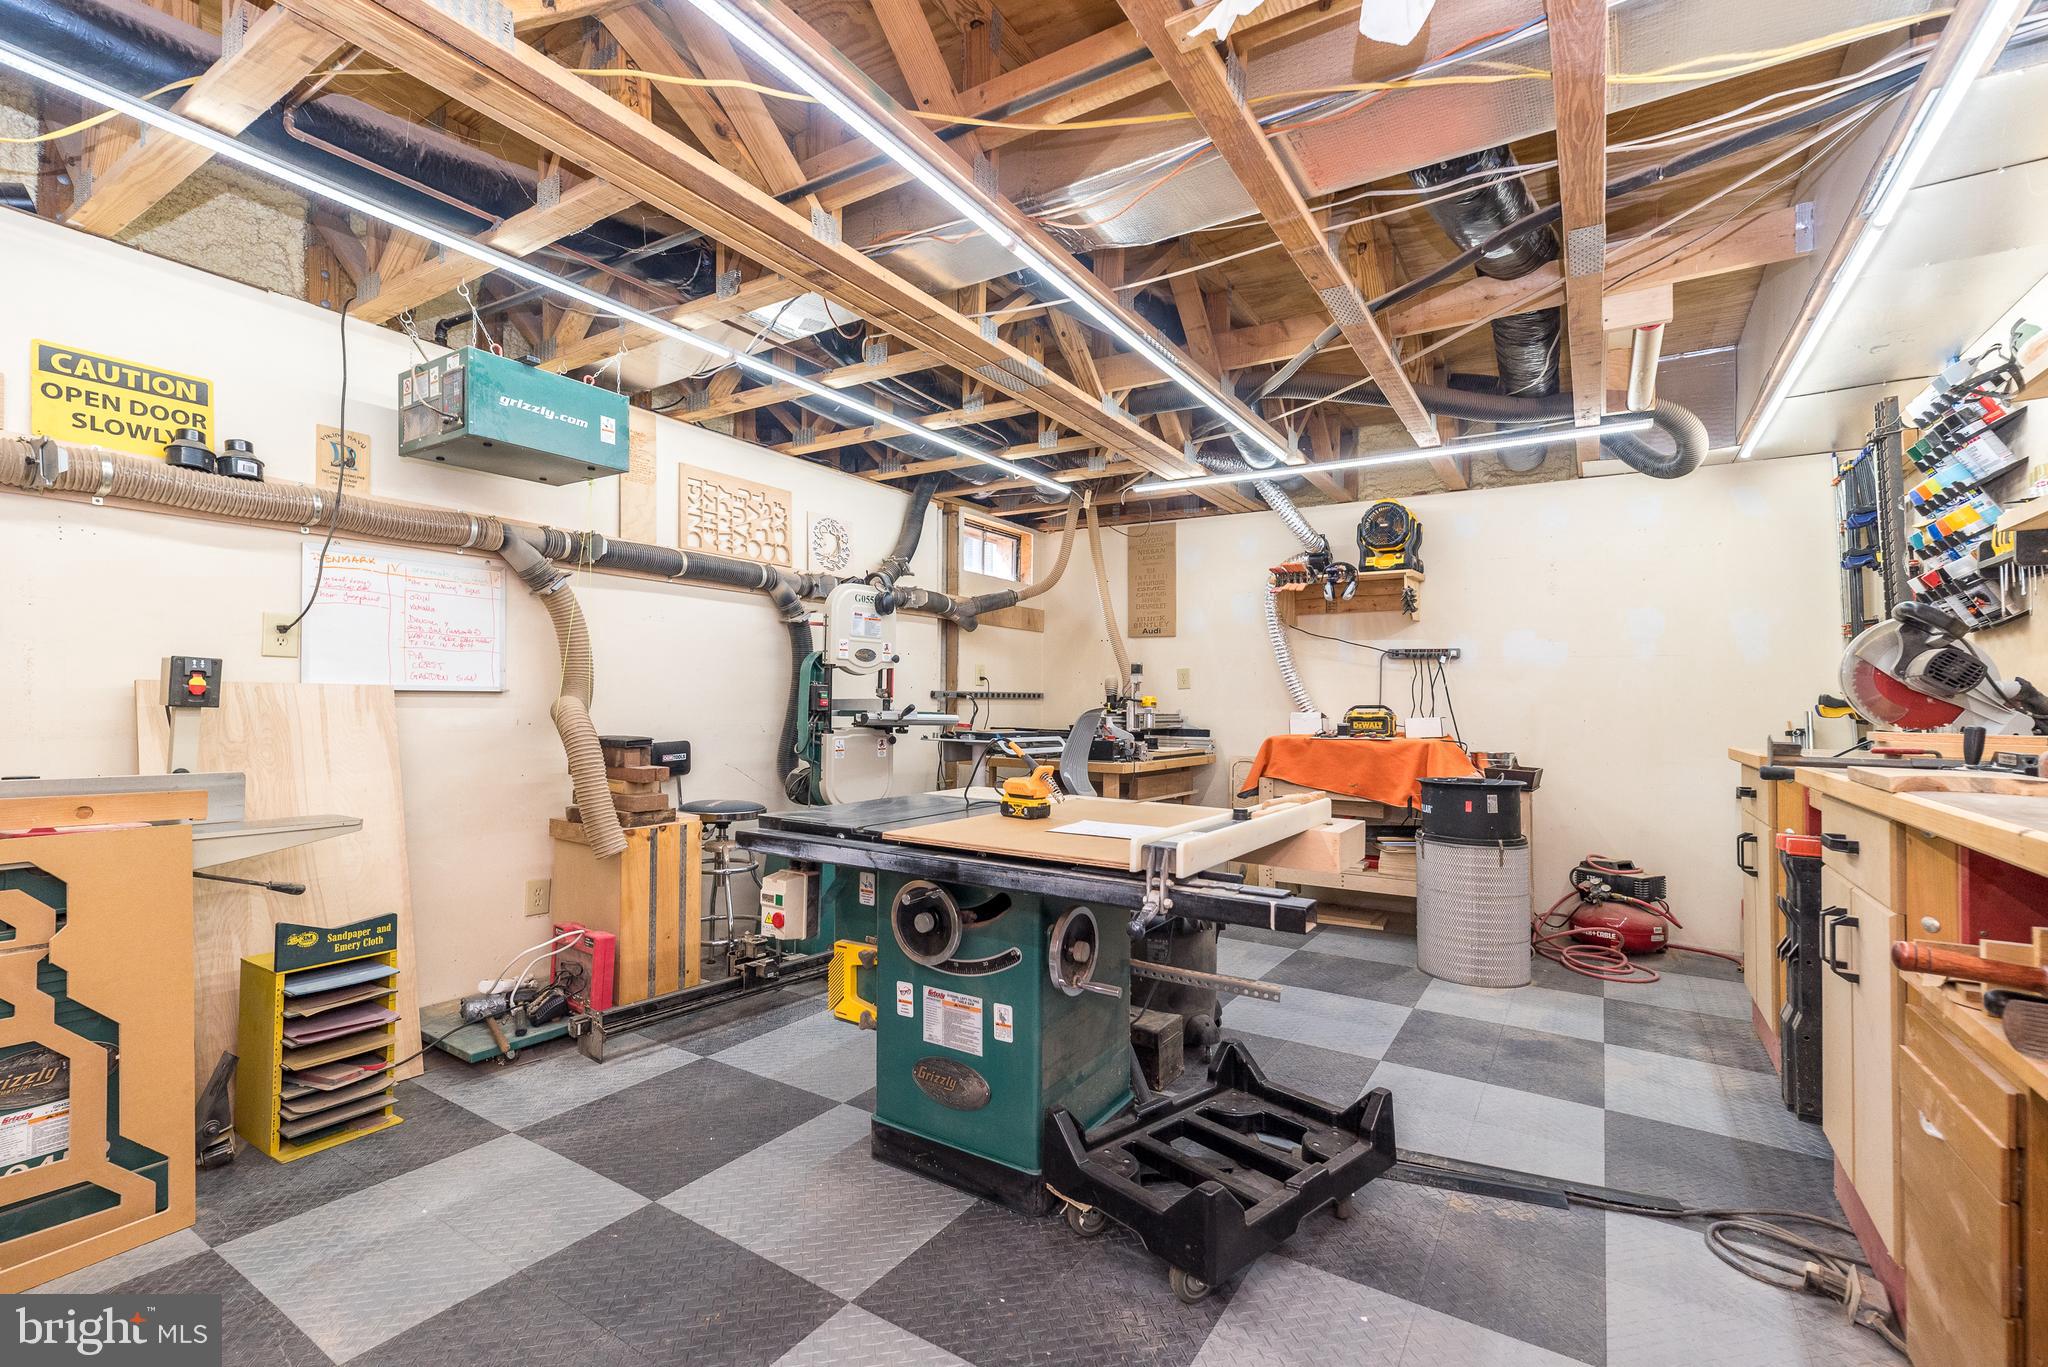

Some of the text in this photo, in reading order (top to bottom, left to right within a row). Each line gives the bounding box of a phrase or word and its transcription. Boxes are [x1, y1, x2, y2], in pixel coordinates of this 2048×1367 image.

[50, 352, 197, 401] CAUTION
[40, 382, 207, 429] OPEN DOOR
[498, 395, 589, 428] grizzly.com
[854, 593, 876, 605] G055
[327, 928, 371, 942] Sandpaper
[376, 923, 391, 933] and
[334, 935, 384, 953] Emery Cloth
[0, 1066, 60, 1089] izzly
[917, 1066, 957, 1091] Grizzly
